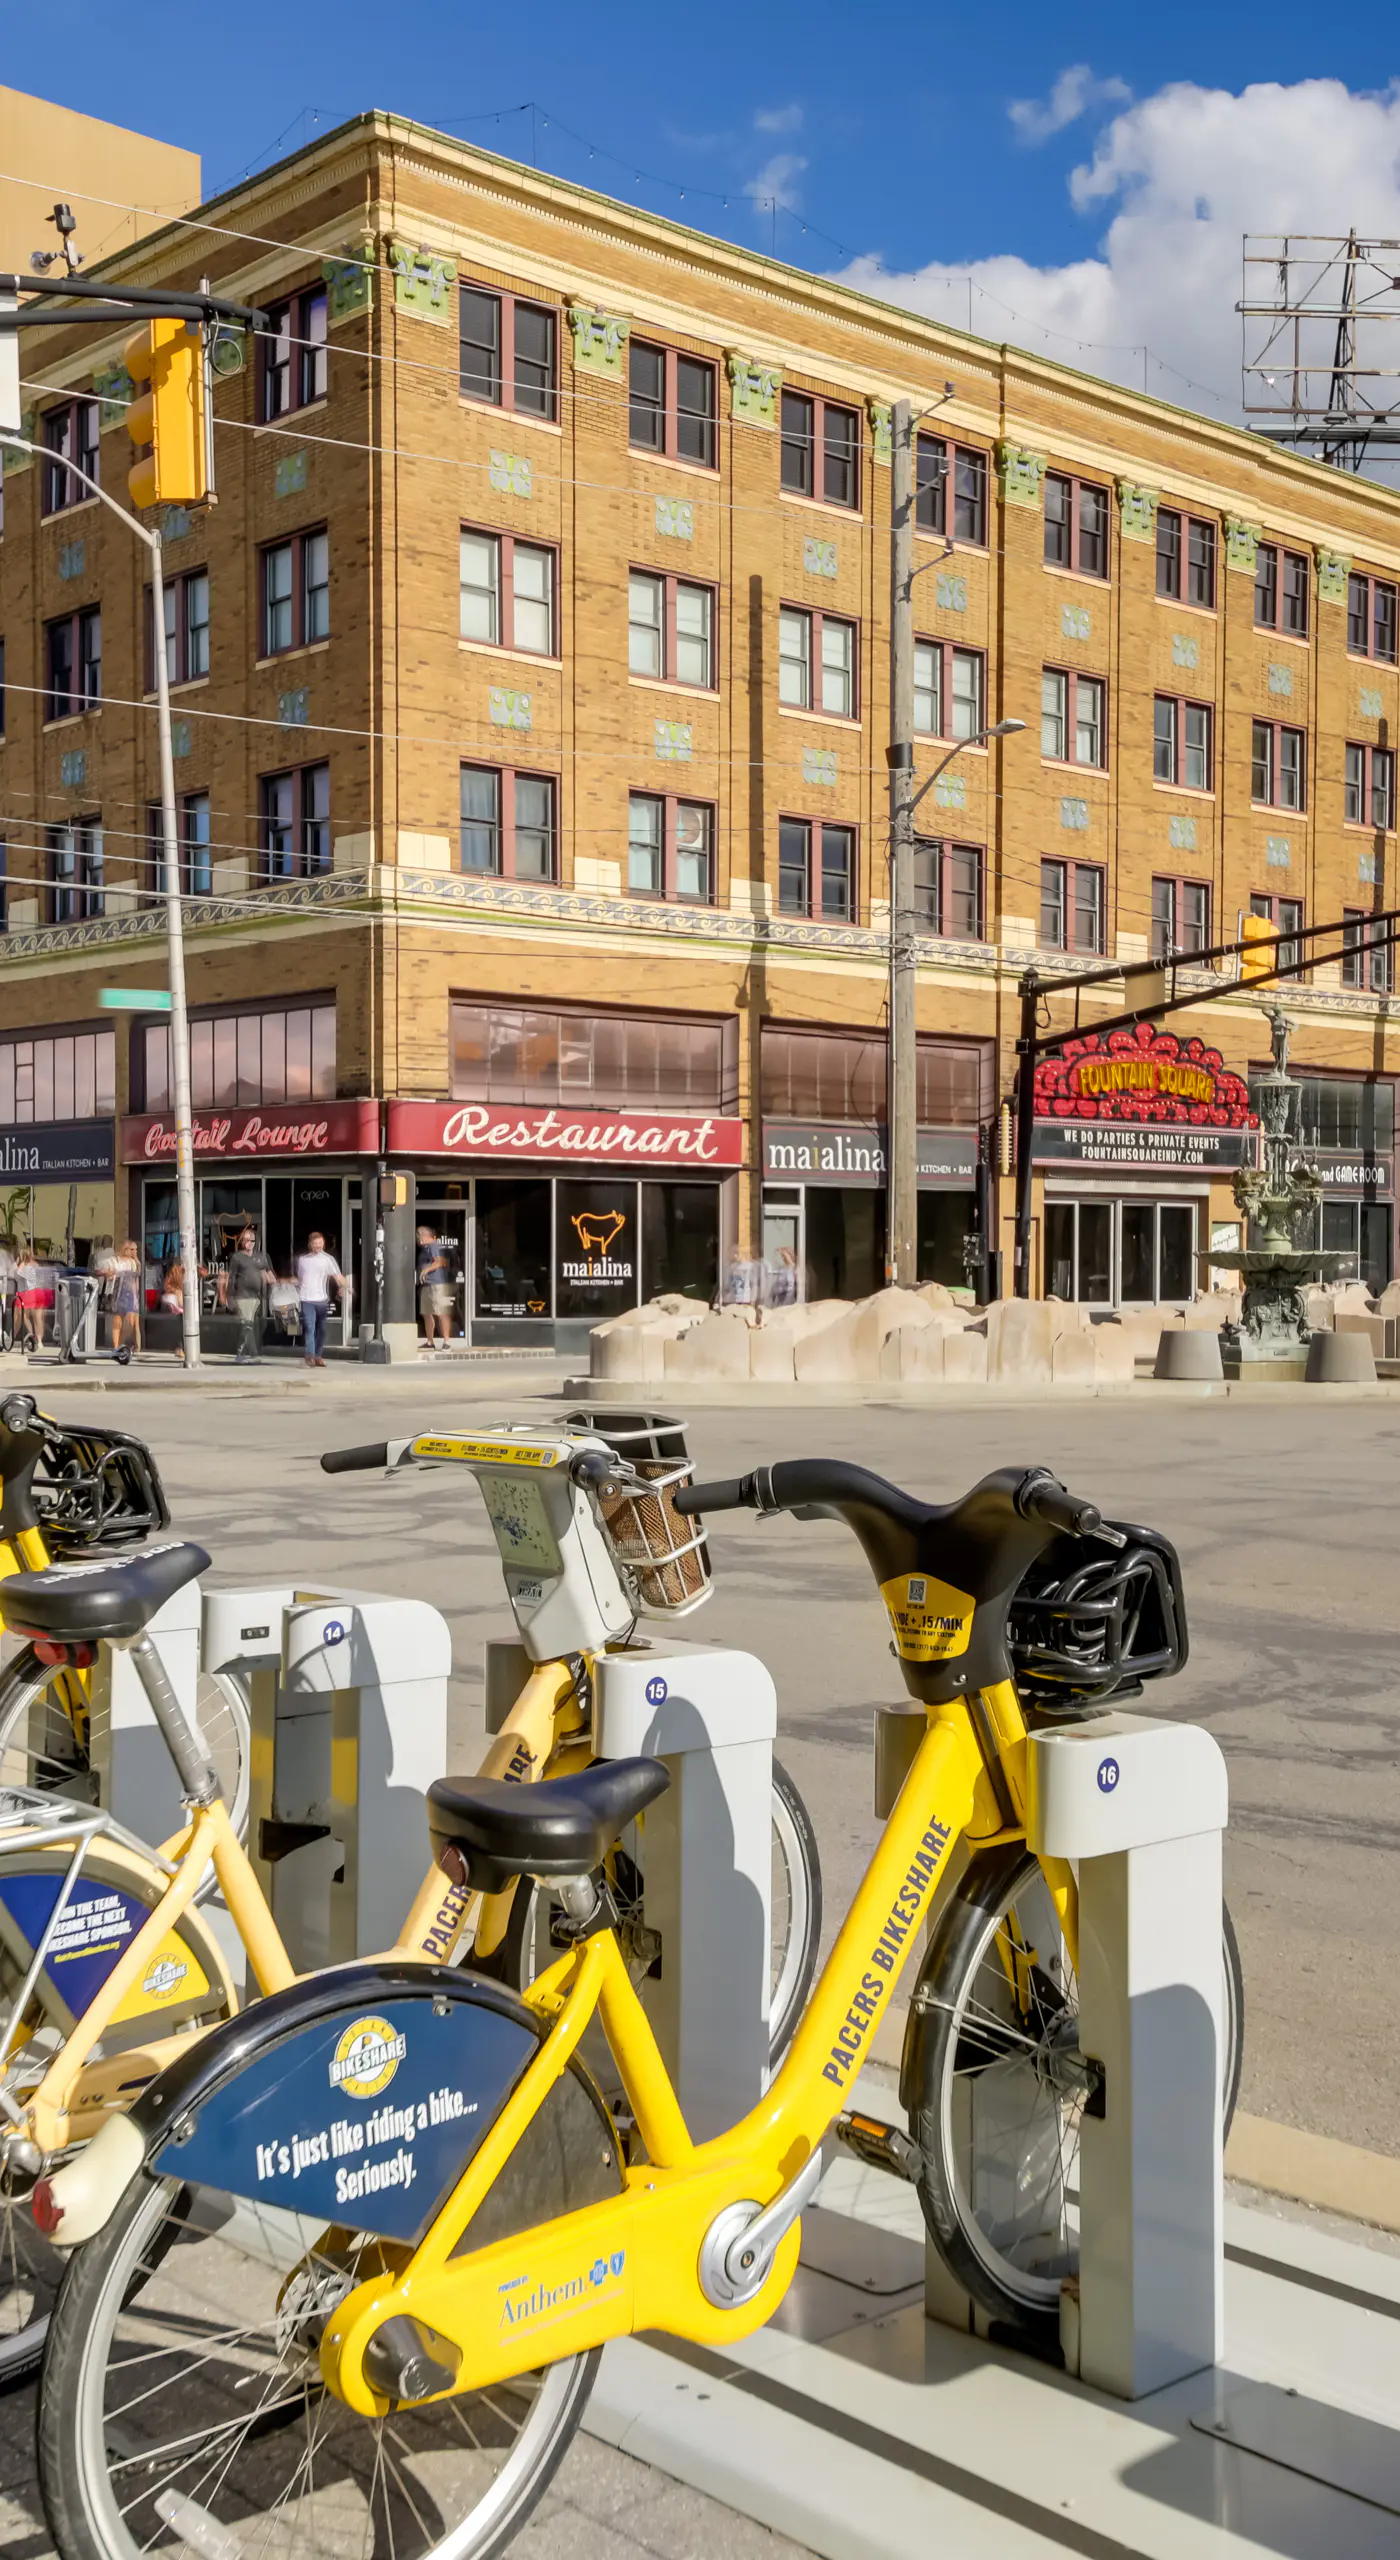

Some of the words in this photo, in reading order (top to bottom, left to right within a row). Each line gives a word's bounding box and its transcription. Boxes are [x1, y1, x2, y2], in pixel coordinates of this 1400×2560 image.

[1079, 1062, 1154, 1095] FOUNTAIN
[232, 1117, 328, 1151] Lounge
[443, 1105, 718, 1159] Restaurant
[1064, 1129, 1077, 1143] WE
[1081, 1130, 1093, 1144] DO
[1097, 1131, 1135, 1146] PARTIES
[1139, 1133, 1145, 1146] &
[1148, 1133, 1186, 1148] PRIVATE
[1188, 1136, 1219, 1150] EVENTS
[42, 1160, 65, 1169] ITALIAN
[66, 1159, 91, 1168] KITCHEN
[97, 1158, 109, 1167] BAR
[769, 1135, 886, 1171] maialina
[1082, 1146, 1203, 1164] FOUNTAINSQUAREINDY.COM
[920, 1164, 951, 1174] KITCHEN
[958, 1165, 972, 1174] BAR
[1335, 1165, 1358, 1183] GAME
[1359, 1167, 1384, 1184] ROOM
[563, 1256, 632, 1277] maialina
[326, 1626, 341, 1640] 14
[918, 1615, 963, 1630] .15/MIN
[649, 1683, 664, 1699] 15
[1100, 1765, 1116, 1784] 16
[76, 1901, 94, 1916] THE
[86, 1912, 104, 1928] THE
[421, 1884, 472, 1960] PACER
[822, 1972, 884, 2088] PACERS
[871, 1814, 952, 1973] BIKESHARE
[332, 2037, 404, 2082] BIKESHARE
[291, 2130, 330, 2180] just
[330, 2119, 364, 2159] like
[365, 2104, 415, 2147] riding
[416, 2102, 428, 2131] a
[428, 2087, 478, 2126] bike...
[335, 2147, 418, 2205] Seriously.
[498, 2276, 584, 2329] Anthem
